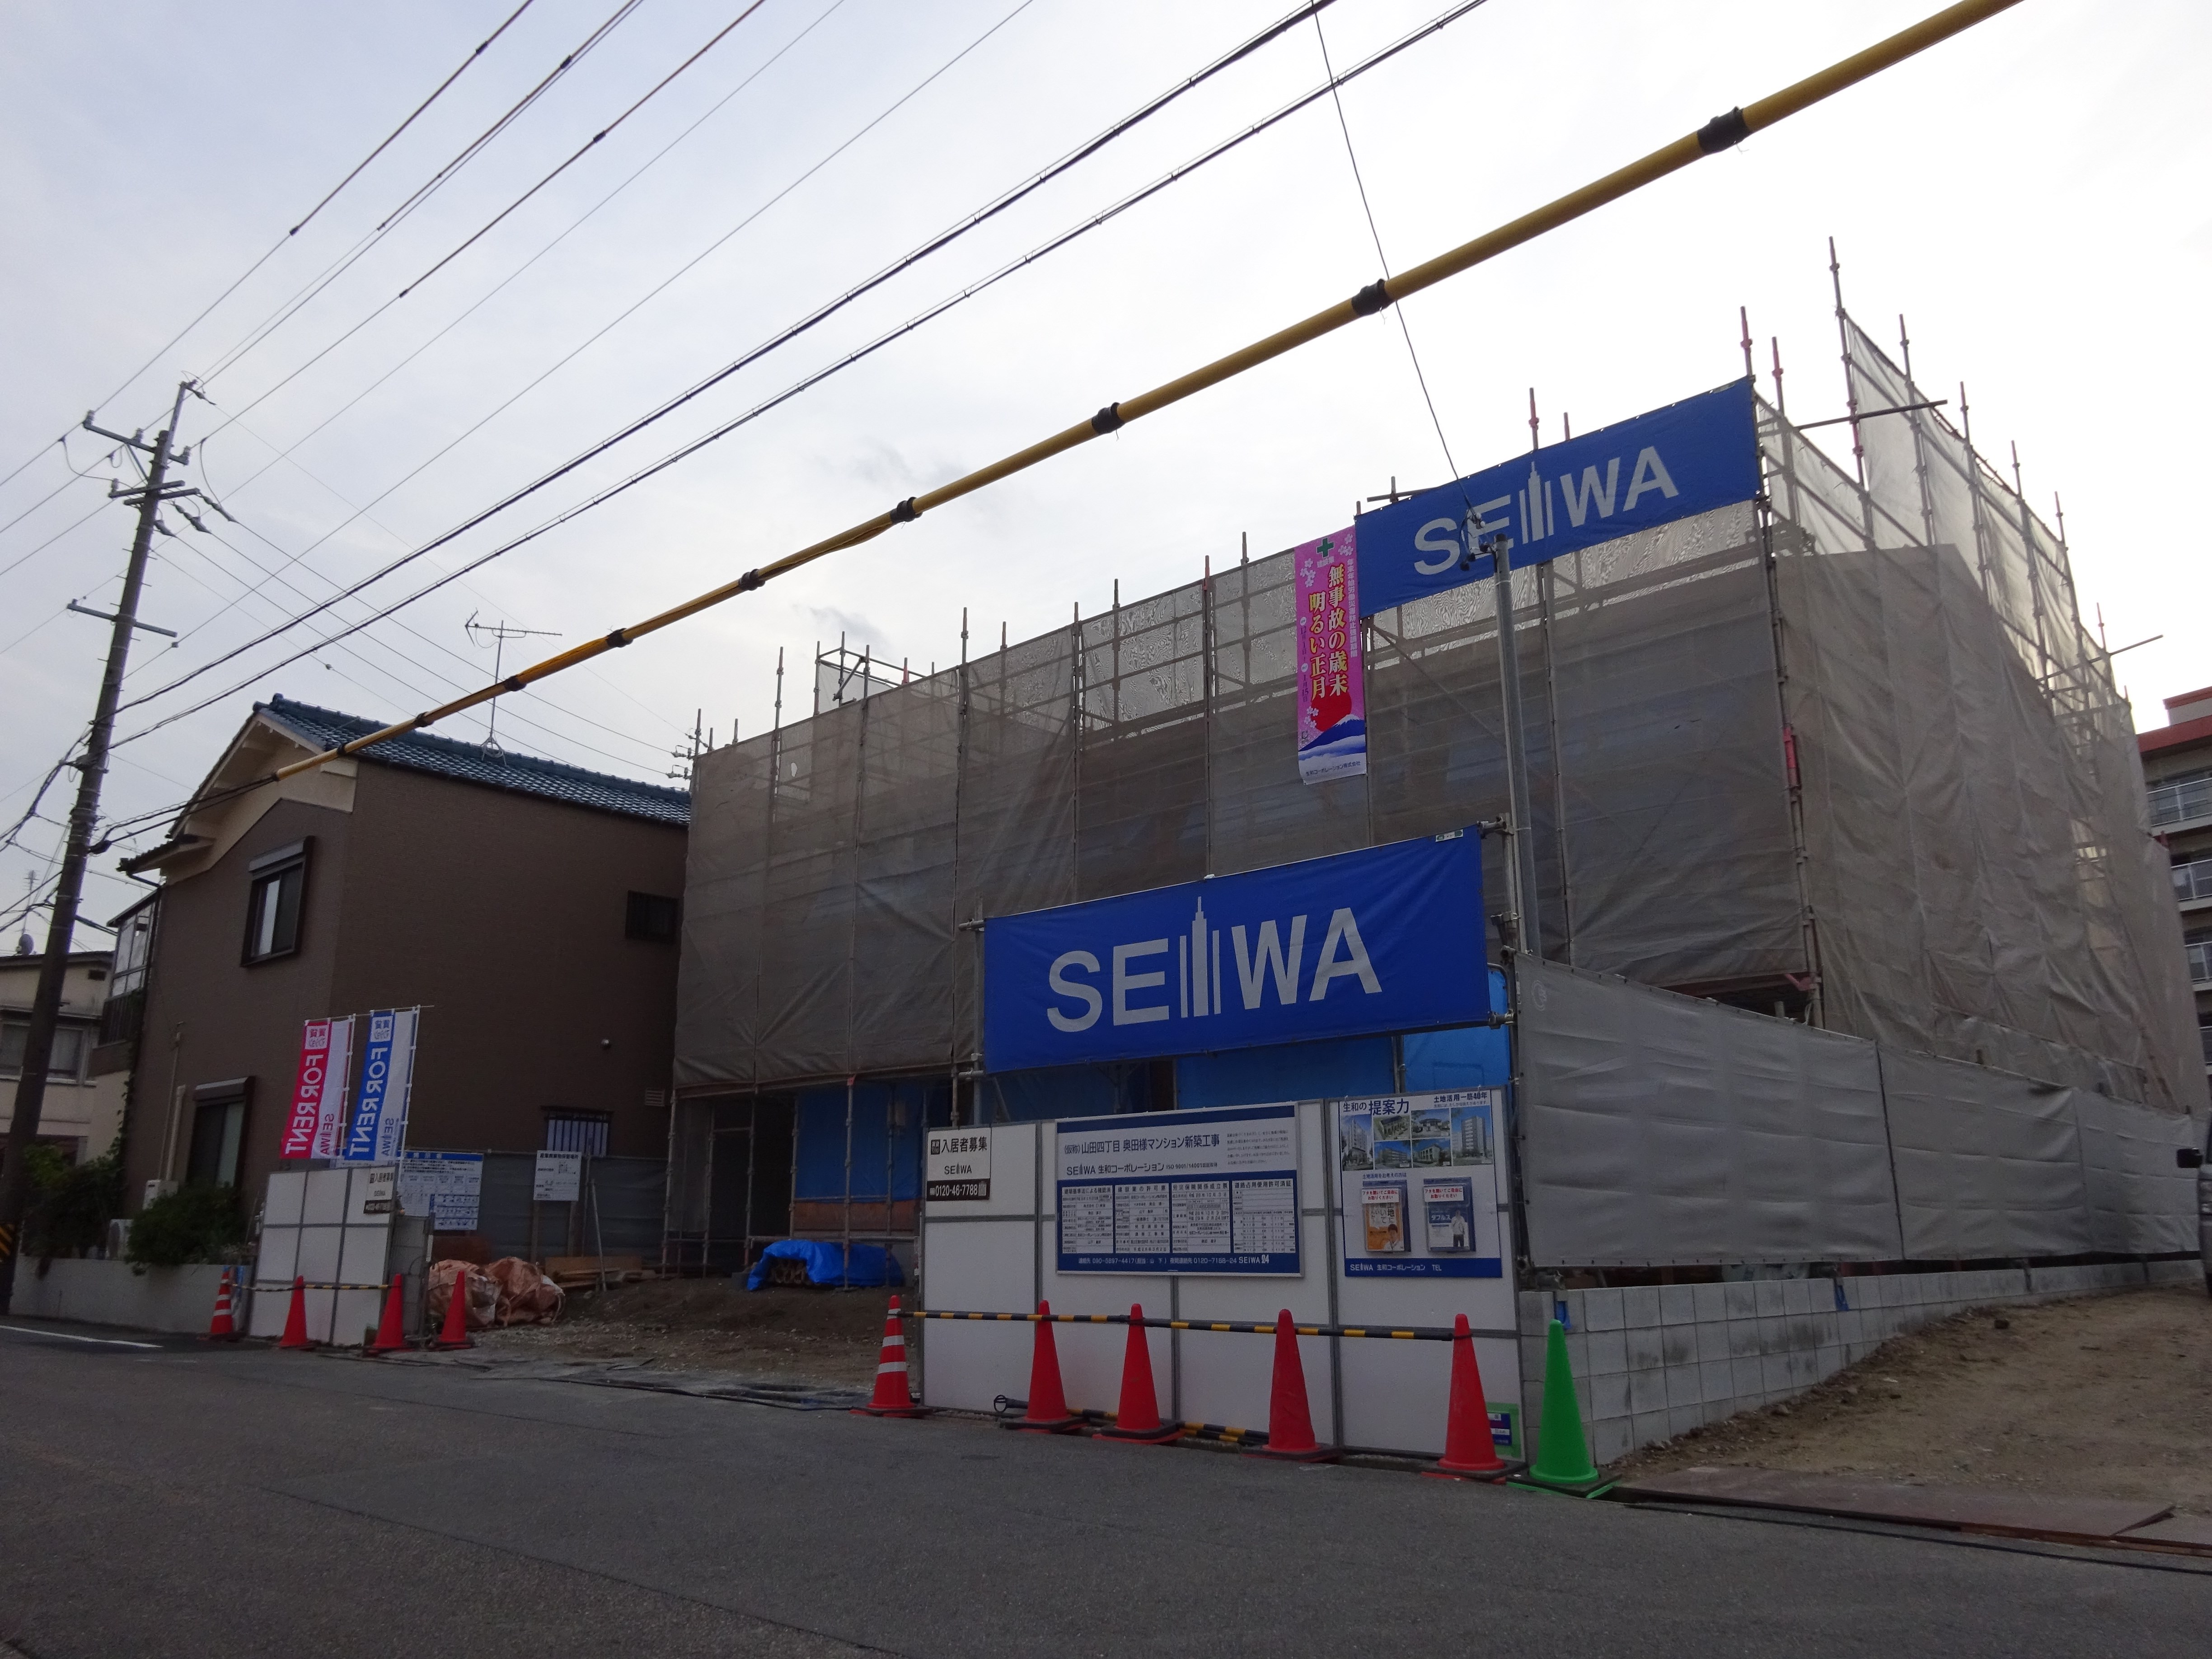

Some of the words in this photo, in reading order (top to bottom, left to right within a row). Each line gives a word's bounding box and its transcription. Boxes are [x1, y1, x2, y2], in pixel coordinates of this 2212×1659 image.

[1414, 446, 1679, 575] SEIWA
[1328, 563, 1348, 697] 無事故の歳末
[1309, 590, 1326, 702] 明るい正月
[1306, 761, 1361, 776] 生和コーポレーション株式会社
[1047, 896, 1382, 1032] SEIWA
[1434, 1092, 1487, 1103] 土地活用一筋40年
[1343, 1098, 1409, 1115] 生和の提案力
[941, 1136, 987, 1153] 入居者募集
[1123, 1134, 1220, 1151] 奥田様マンション新築工事
[944, 1162, 972, 1175] SEIWA
[1067, 1163, 1096, 1176] SEIWA
[1098, 1163, 1164, 1174] 生和コーポレーション
[935, 1184, 978, 1196] 0120-46-7788
[1235, 1181, 1291, 1189] 道路占用使用許可済証
[1350, 1263, 1373, 1271] SEIWA
